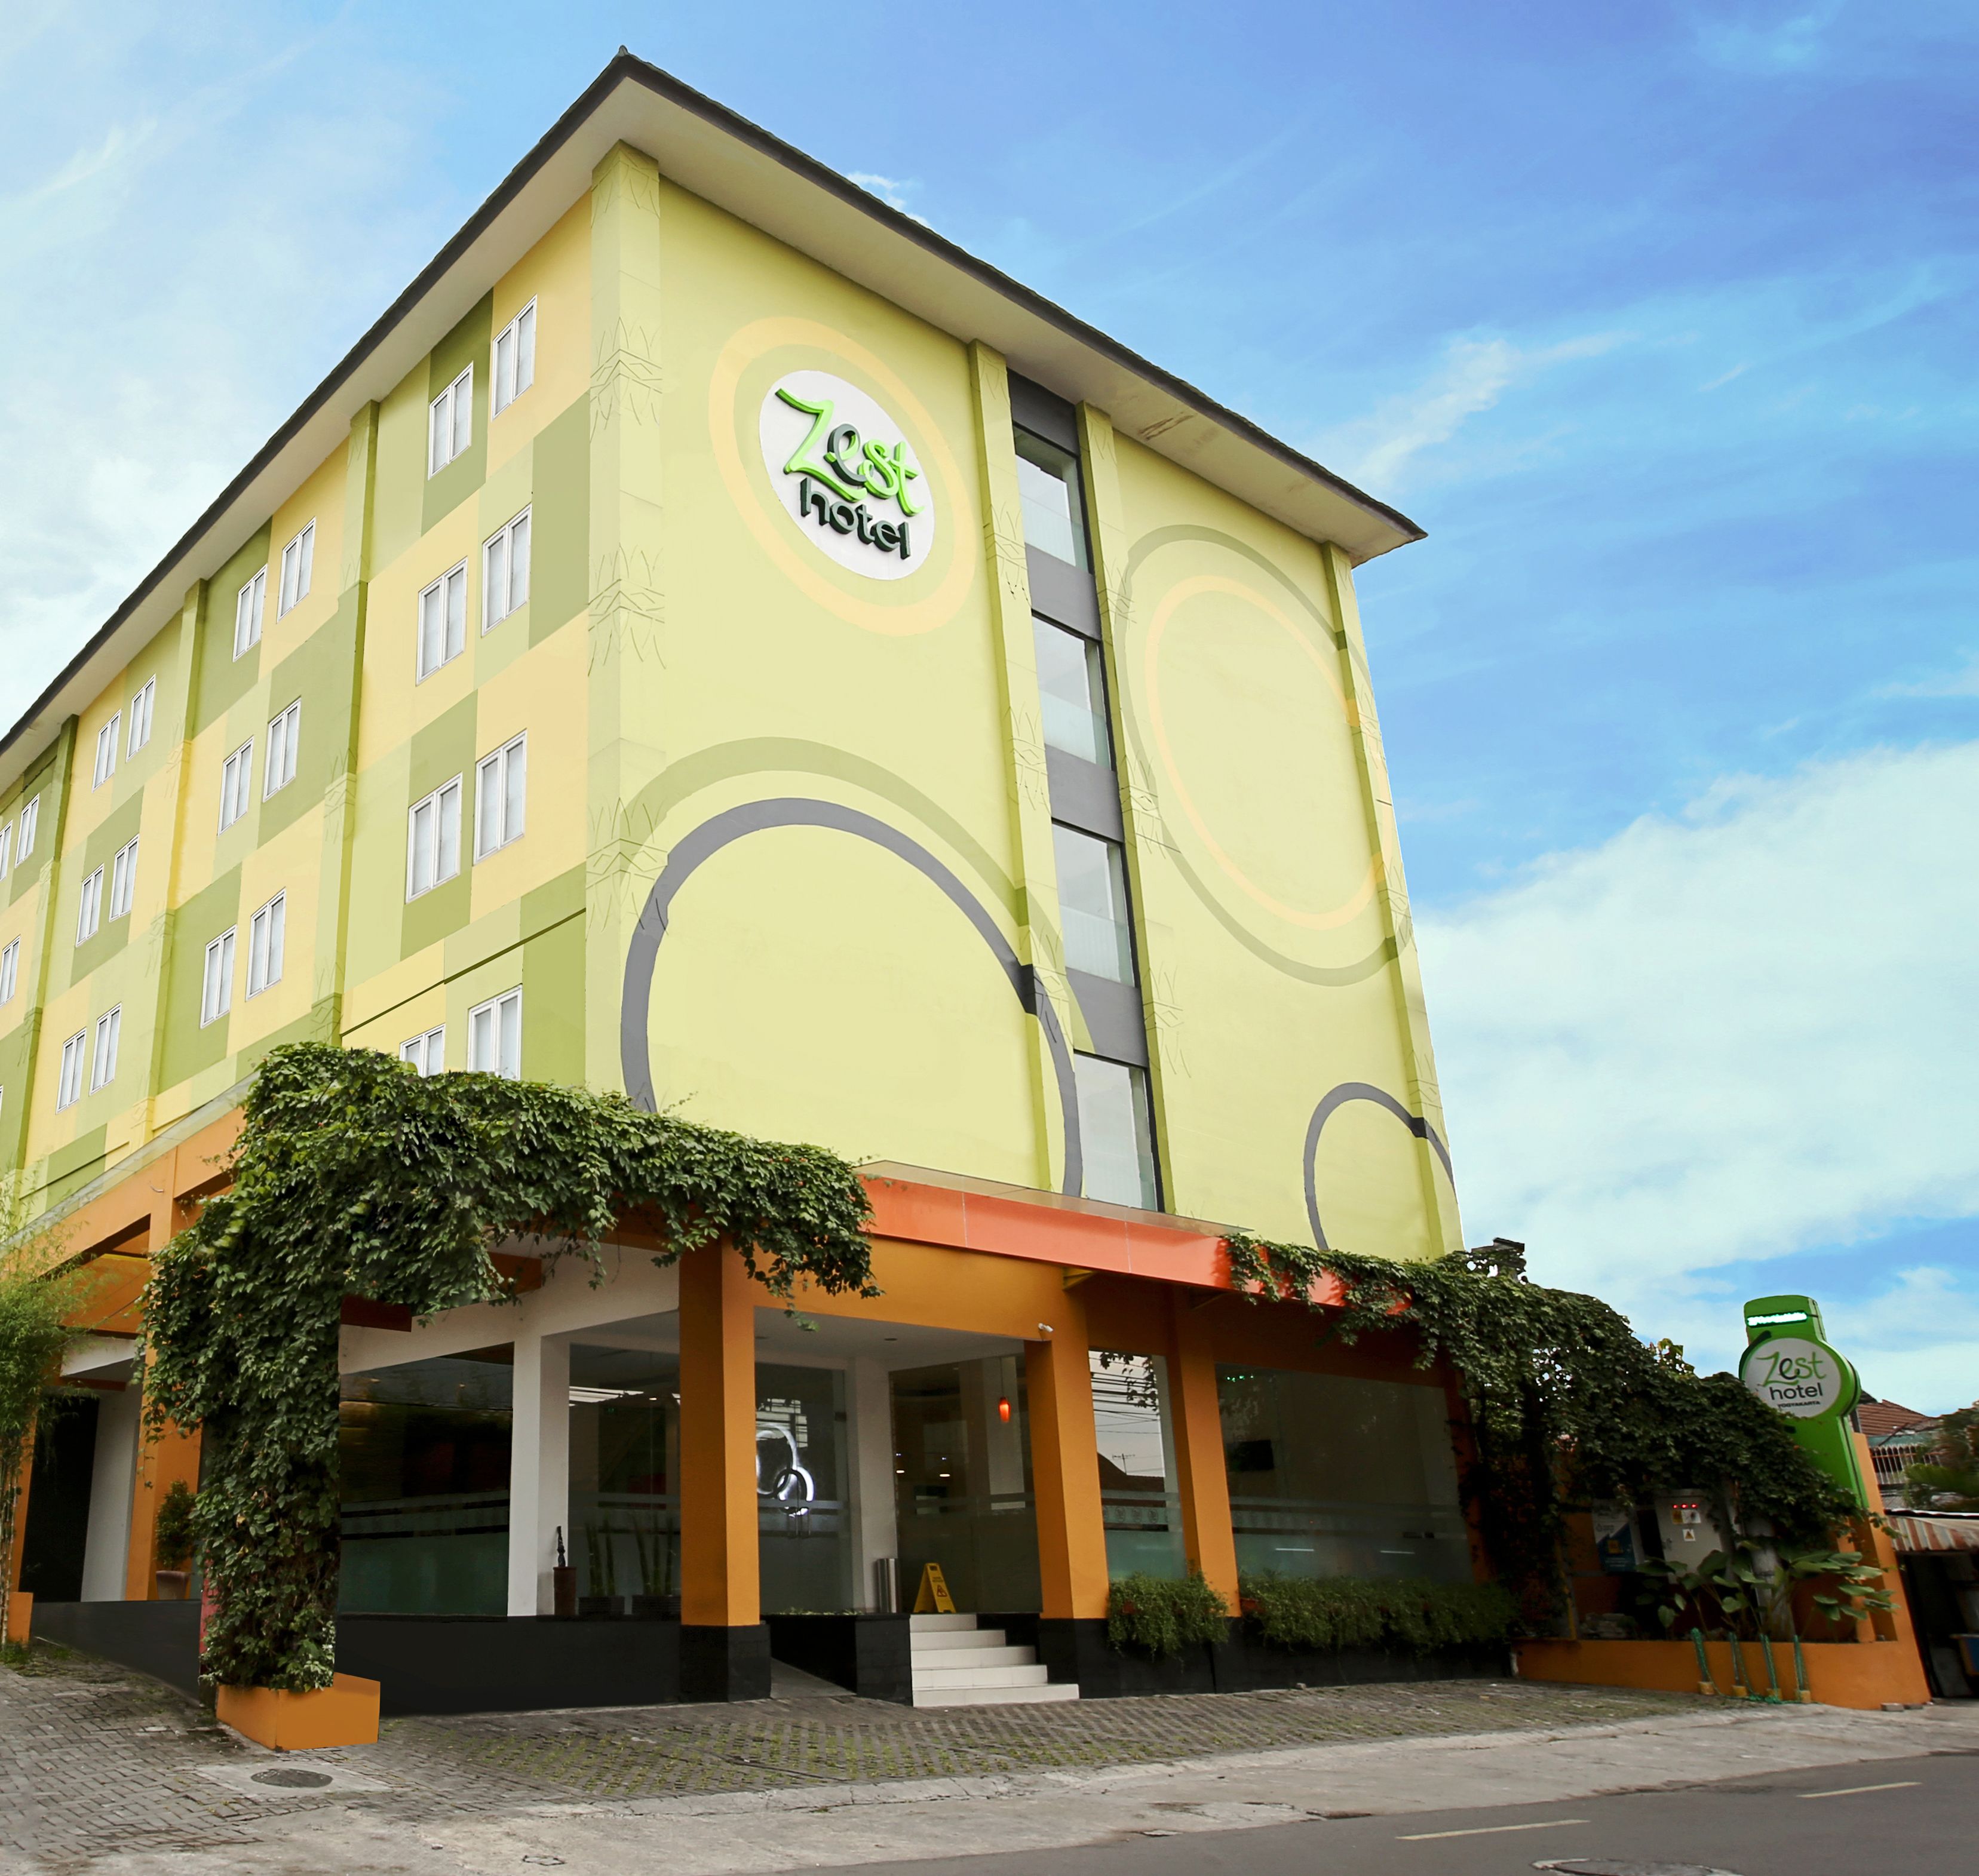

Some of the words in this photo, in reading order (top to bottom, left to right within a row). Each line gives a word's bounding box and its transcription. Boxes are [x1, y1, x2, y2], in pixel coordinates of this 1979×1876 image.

[775, 388, 925, 517] Zest
[800, 477, 911, 560] hotel
[1756, 1351, 1827, 1387] Zest
[1769, 1382, 1823, 1401] hotel
